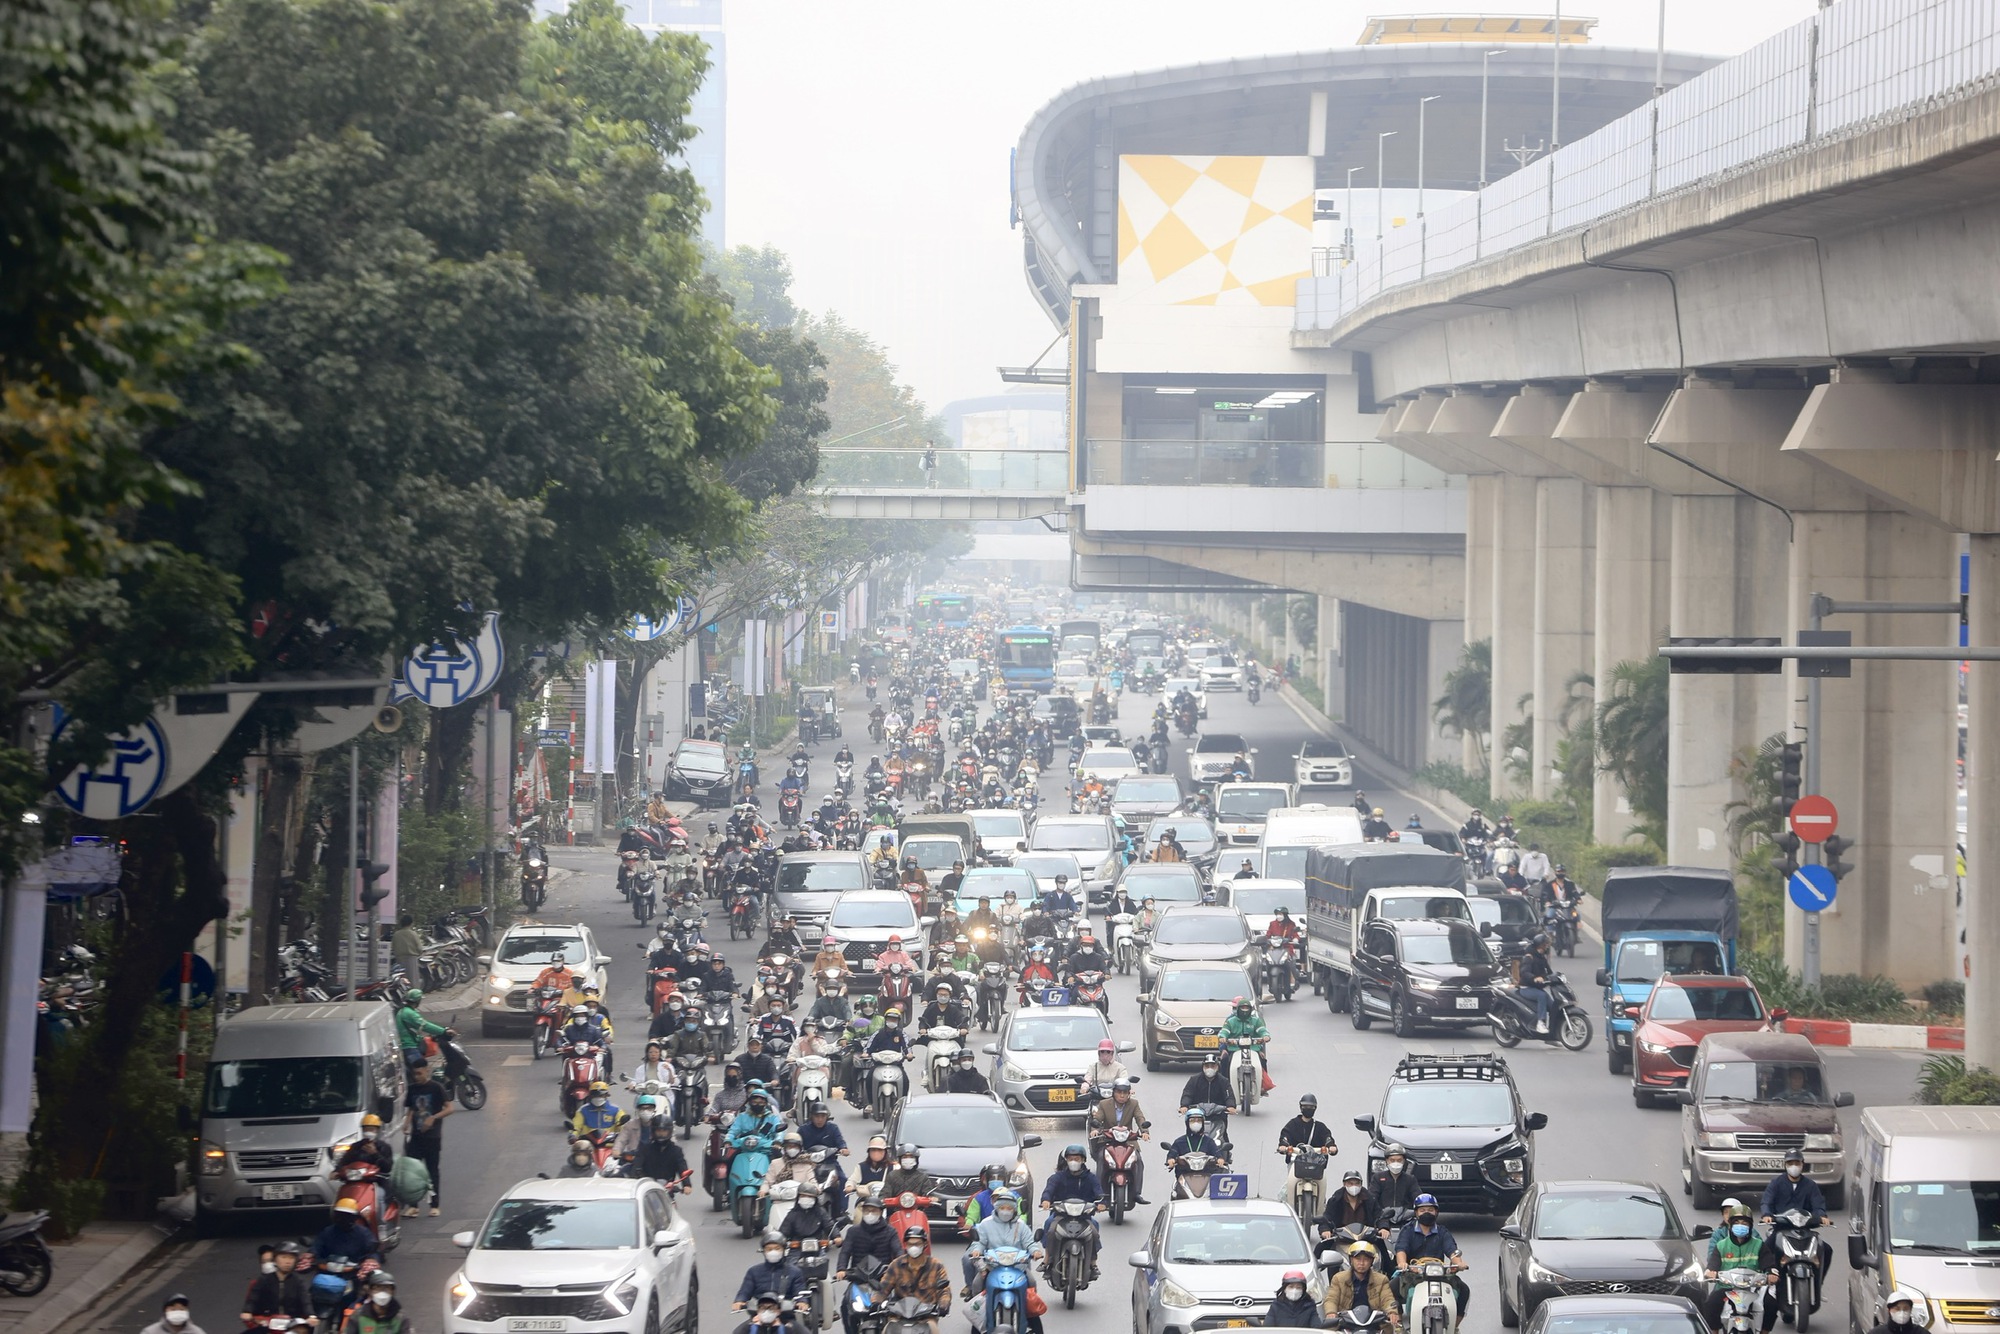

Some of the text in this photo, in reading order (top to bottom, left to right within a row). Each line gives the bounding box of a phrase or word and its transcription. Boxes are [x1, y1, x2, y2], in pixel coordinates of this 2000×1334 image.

[1048, 990, 1063, 1005] G7
[1440, 1164, 1453, 1172] 17A
[1434, 1172, 1459, 1180] 307.33
[1218, 1176, 1239, 1197] G7
[512, 1320, 562, 1329] 30K-711.03
